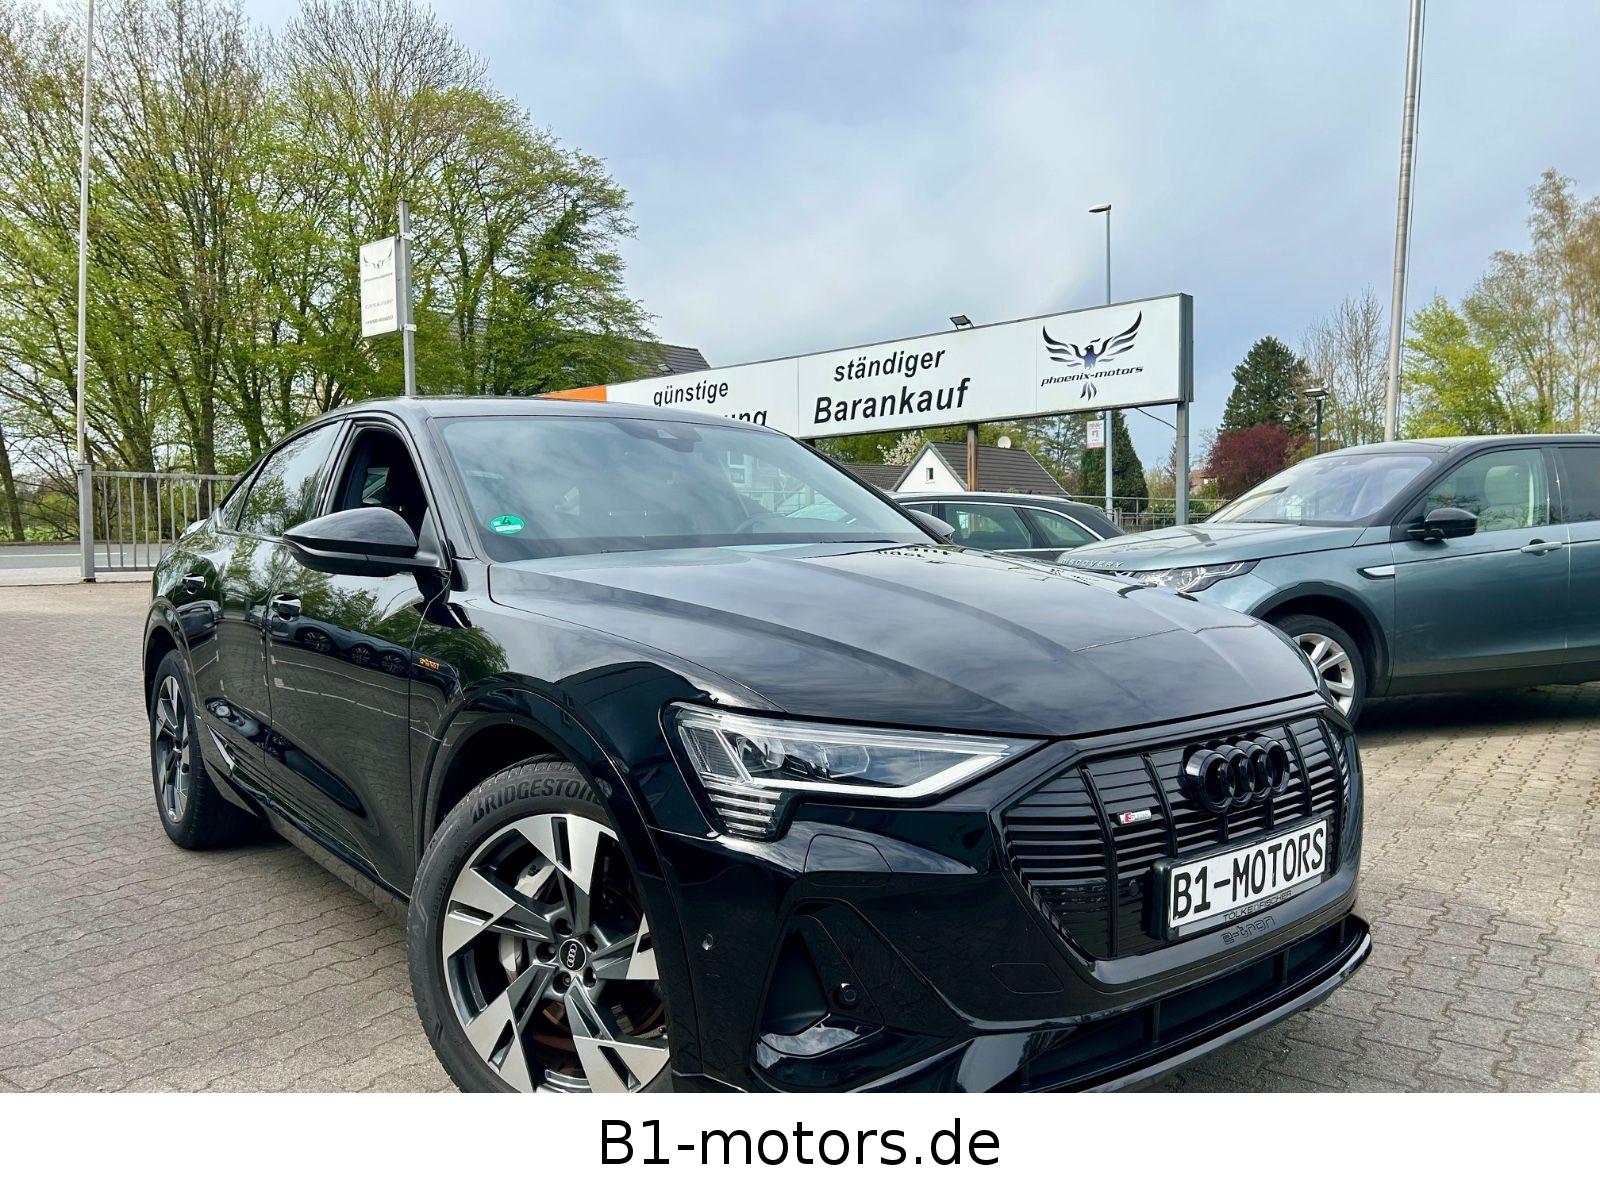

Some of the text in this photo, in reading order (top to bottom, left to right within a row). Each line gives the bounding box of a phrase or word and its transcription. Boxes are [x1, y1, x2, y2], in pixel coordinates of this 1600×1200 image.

[833, 350, 946, 382] ständiger
[1040, 366, 1144, 387] phoenix-motors
[653, 379, 729, 407] günstige
[813, 377, 971, 425] Barankauf
[1172, 828, 1324, 921] B1-MOTORS
[1221, 915, 1276, 945] e-tron
